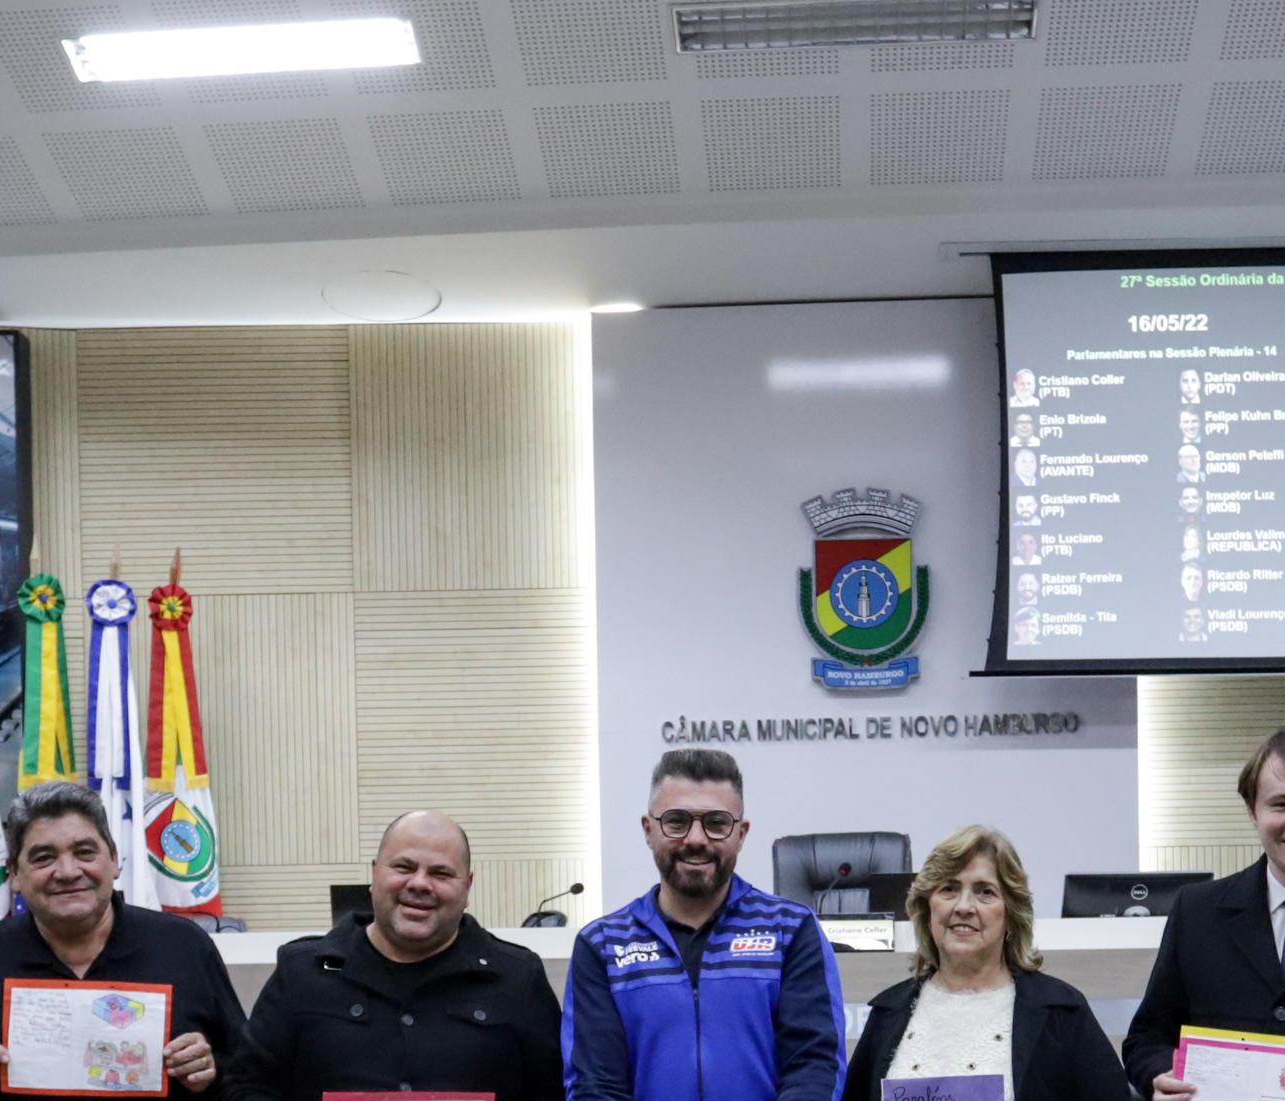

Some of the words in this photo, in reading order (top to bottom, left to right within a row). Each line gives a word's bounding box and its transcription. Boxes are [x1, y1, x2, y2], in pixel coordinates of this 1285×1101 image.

[1120, 276, 1142, 288] 27ª
[1146, 274, 1196, 287] Sessão
[1200, 274, 1263, 286] Ordinária
[1267, 273, 1284, 285] da
[1128, 314, 1208, 332] 16/05/22
[1067, 349, 1146, 361] Parlamentares
[1149, 350, 1162, 358] na
[1166, 347, 1205, 358] Sessão
[1209, 346, 1254, 358] Plenária
[1264, 346, 1277, 356] 14
[1039, 375, 1088, 386] Cristiano
[1092, 374, 1125, 385] Coller
[1204, 372, 1239, 382] Darlan
[1243, 371, 1285, 382] Oliveira
[1039, 387, 1070, 399] (PTB)
[1204, 383, 1236, 395] (PDT)
[1039, 415, 1065, 425] Enio
[1067, 414, 1106, 424] Brizola
[1205, 410, 1238, 423] Felipe
[1242, 410, 1270, 420] Kuhn
[1039, 427, 1063, 438] (PT)
[1205, 423, 1229, 435] (PP)
[1040, 454, 1092, 464] Fernando
[1096, 453, 1148, 465] Lourenço
[1206, 451, 1246, 462] Gerson
[1040, 466, 1094, 477] (AVANTE)
[1206, 462, 1240, 474] (MDB)
[1041, 494, 1086, 505] Gustavo
[1089, 493, 1120, 503] Finck
[1206, 490, 1251, 503] Inspetor
[1254, 490, 1275, 500] Luz
[1041, 505, 1064, 517] (PP)
[1206, 502, 1241, 514] (MDB)
[1041, 534, 1055, 544] Ito
[1059, 533, 1102, 543] Luciano
[1207, 530, 1252, 542] Lourdes
[1255, 529, 1285, 540] Valim
[1042, 545, 1072, 557] (PTB)
[1042, 574, 1076, 584] Raizer
[1080, 572, 1122, 583] Ferreira
[1208, 570, 1250, 581] Ricardo
[1253, 569, 1283, 580] Ritter
[1042, 584, 1082, 596] (PSDB)
[1208, 581, 1247, 593] (PSDB)
[1042, 612, 1086, 624] Semilda
[1097, 612, 1117, 622] Tita
[1208, 609, 1239, 620] Vladi
[1042, 624, 1082, 636] (PSDB)
[1208, 620, 1248, 633] (PSDB)
[854, 670, 904, 679] HAMBURGO
[662, 716, 751, 744] CÂMARA
[757, 716, 860, 742] MUNICIPAL
[866, 715, 891, 739] DE
[900, 715, 958, 738] NOVO
[964, 714, 1081, 737] HAMBURGO
